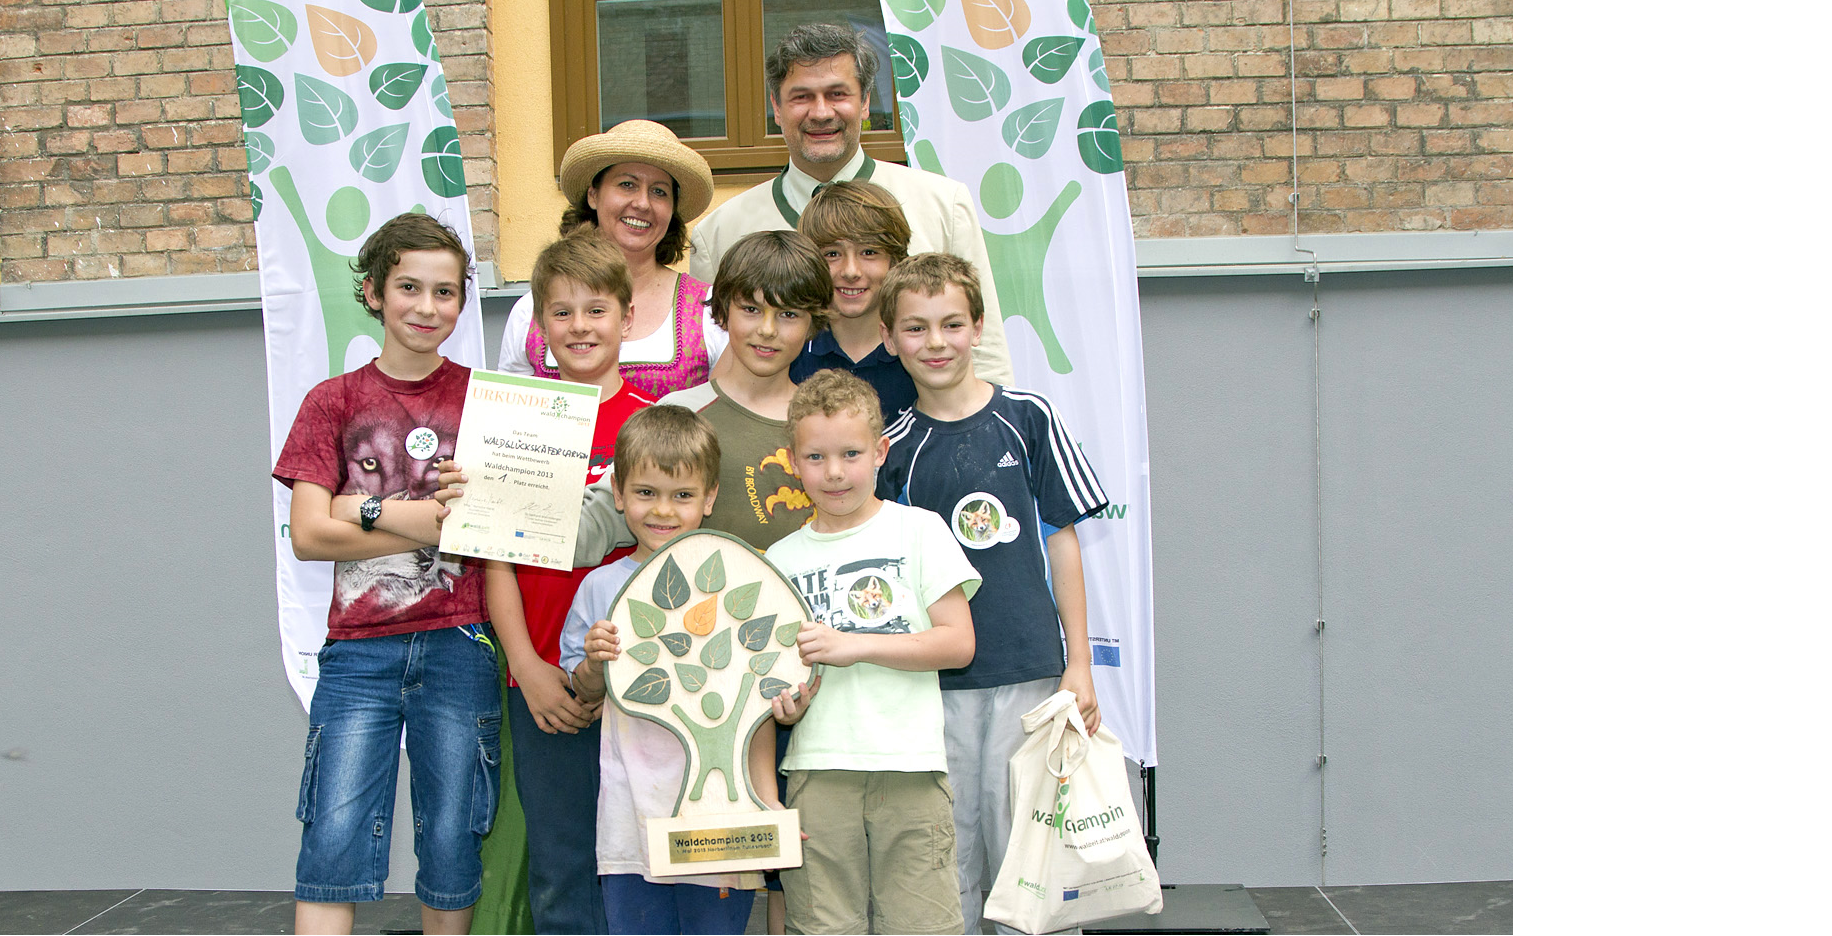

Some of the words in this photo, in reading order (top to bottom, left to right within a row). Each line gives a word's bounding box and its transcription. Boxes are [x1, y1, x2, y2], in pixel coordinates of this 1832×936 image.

[473, 387, 550, 409] URKUNDE
[560, 413, 591, 423] champion
[523, 431, 538, 439] Team
[516, 455, 551, 466] Wettbewerb
[996, 460, 1019, 468] adidas
[484, 461, 536, 476] Waldchampion
[536, 470, 554, 479] 2013
[745, 465, 755, 477] BY
[513, 479, 527, 487] Platz
[527, 482, 551, 490] erreicht.
[744, 477, 769, 524] BROADWAY
[675, 834, 747, 848] Waldchampion
[750, 832, 774, 843] 2013
